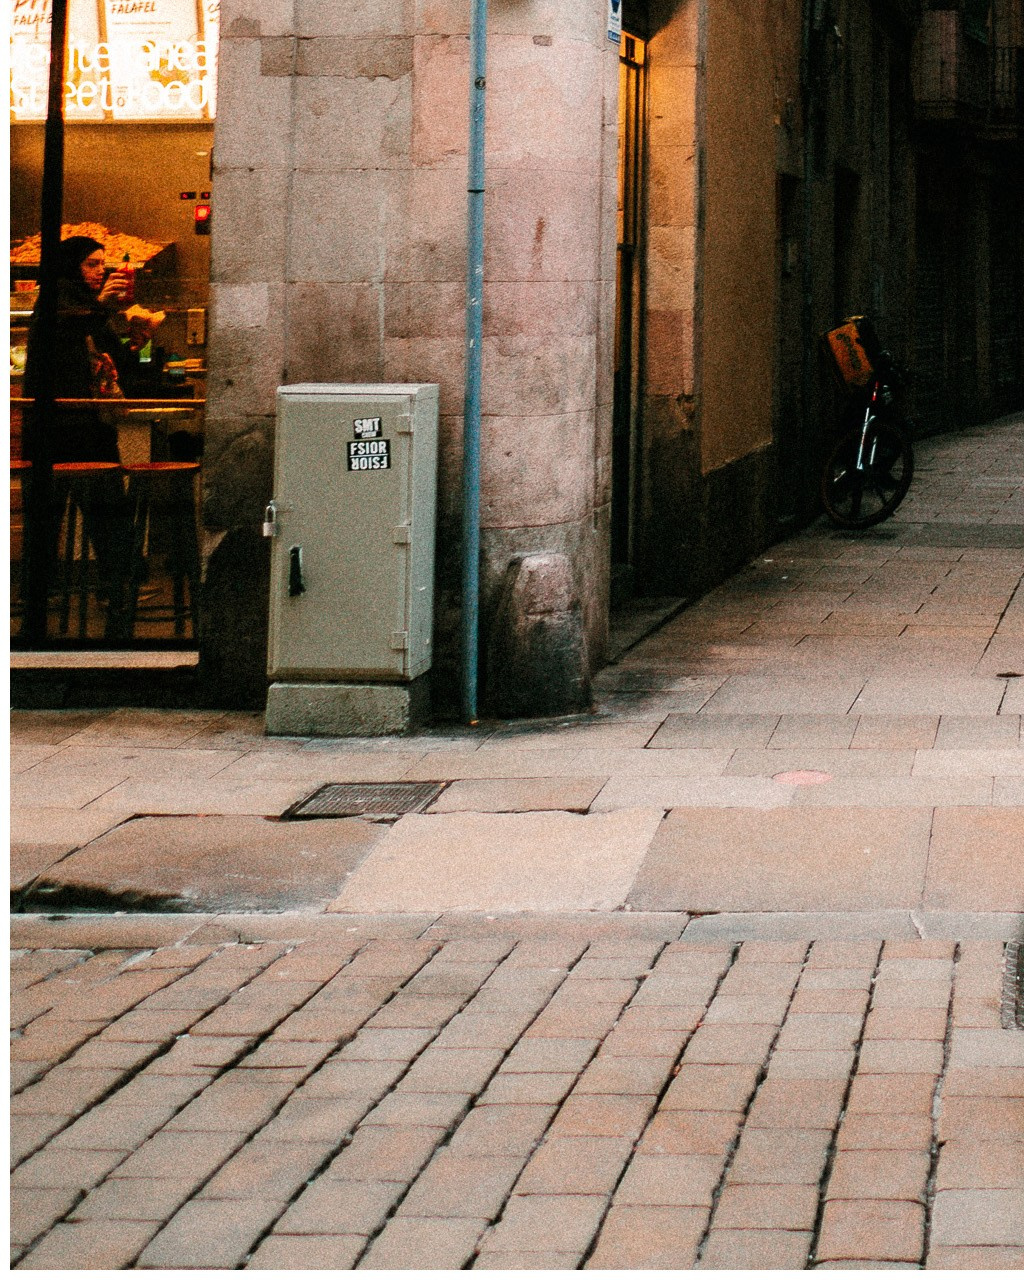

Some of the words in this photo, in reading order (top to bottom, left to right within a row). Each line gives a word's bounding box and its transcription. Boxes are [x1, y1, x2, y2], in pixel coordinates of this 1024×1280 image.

[111, 1, 157, 14] FALAFEL
[13, 14, 53, 26] FALAFE
[354, 417, 380, 433] SMT
[349, 441, 387, 455] FSIOR
